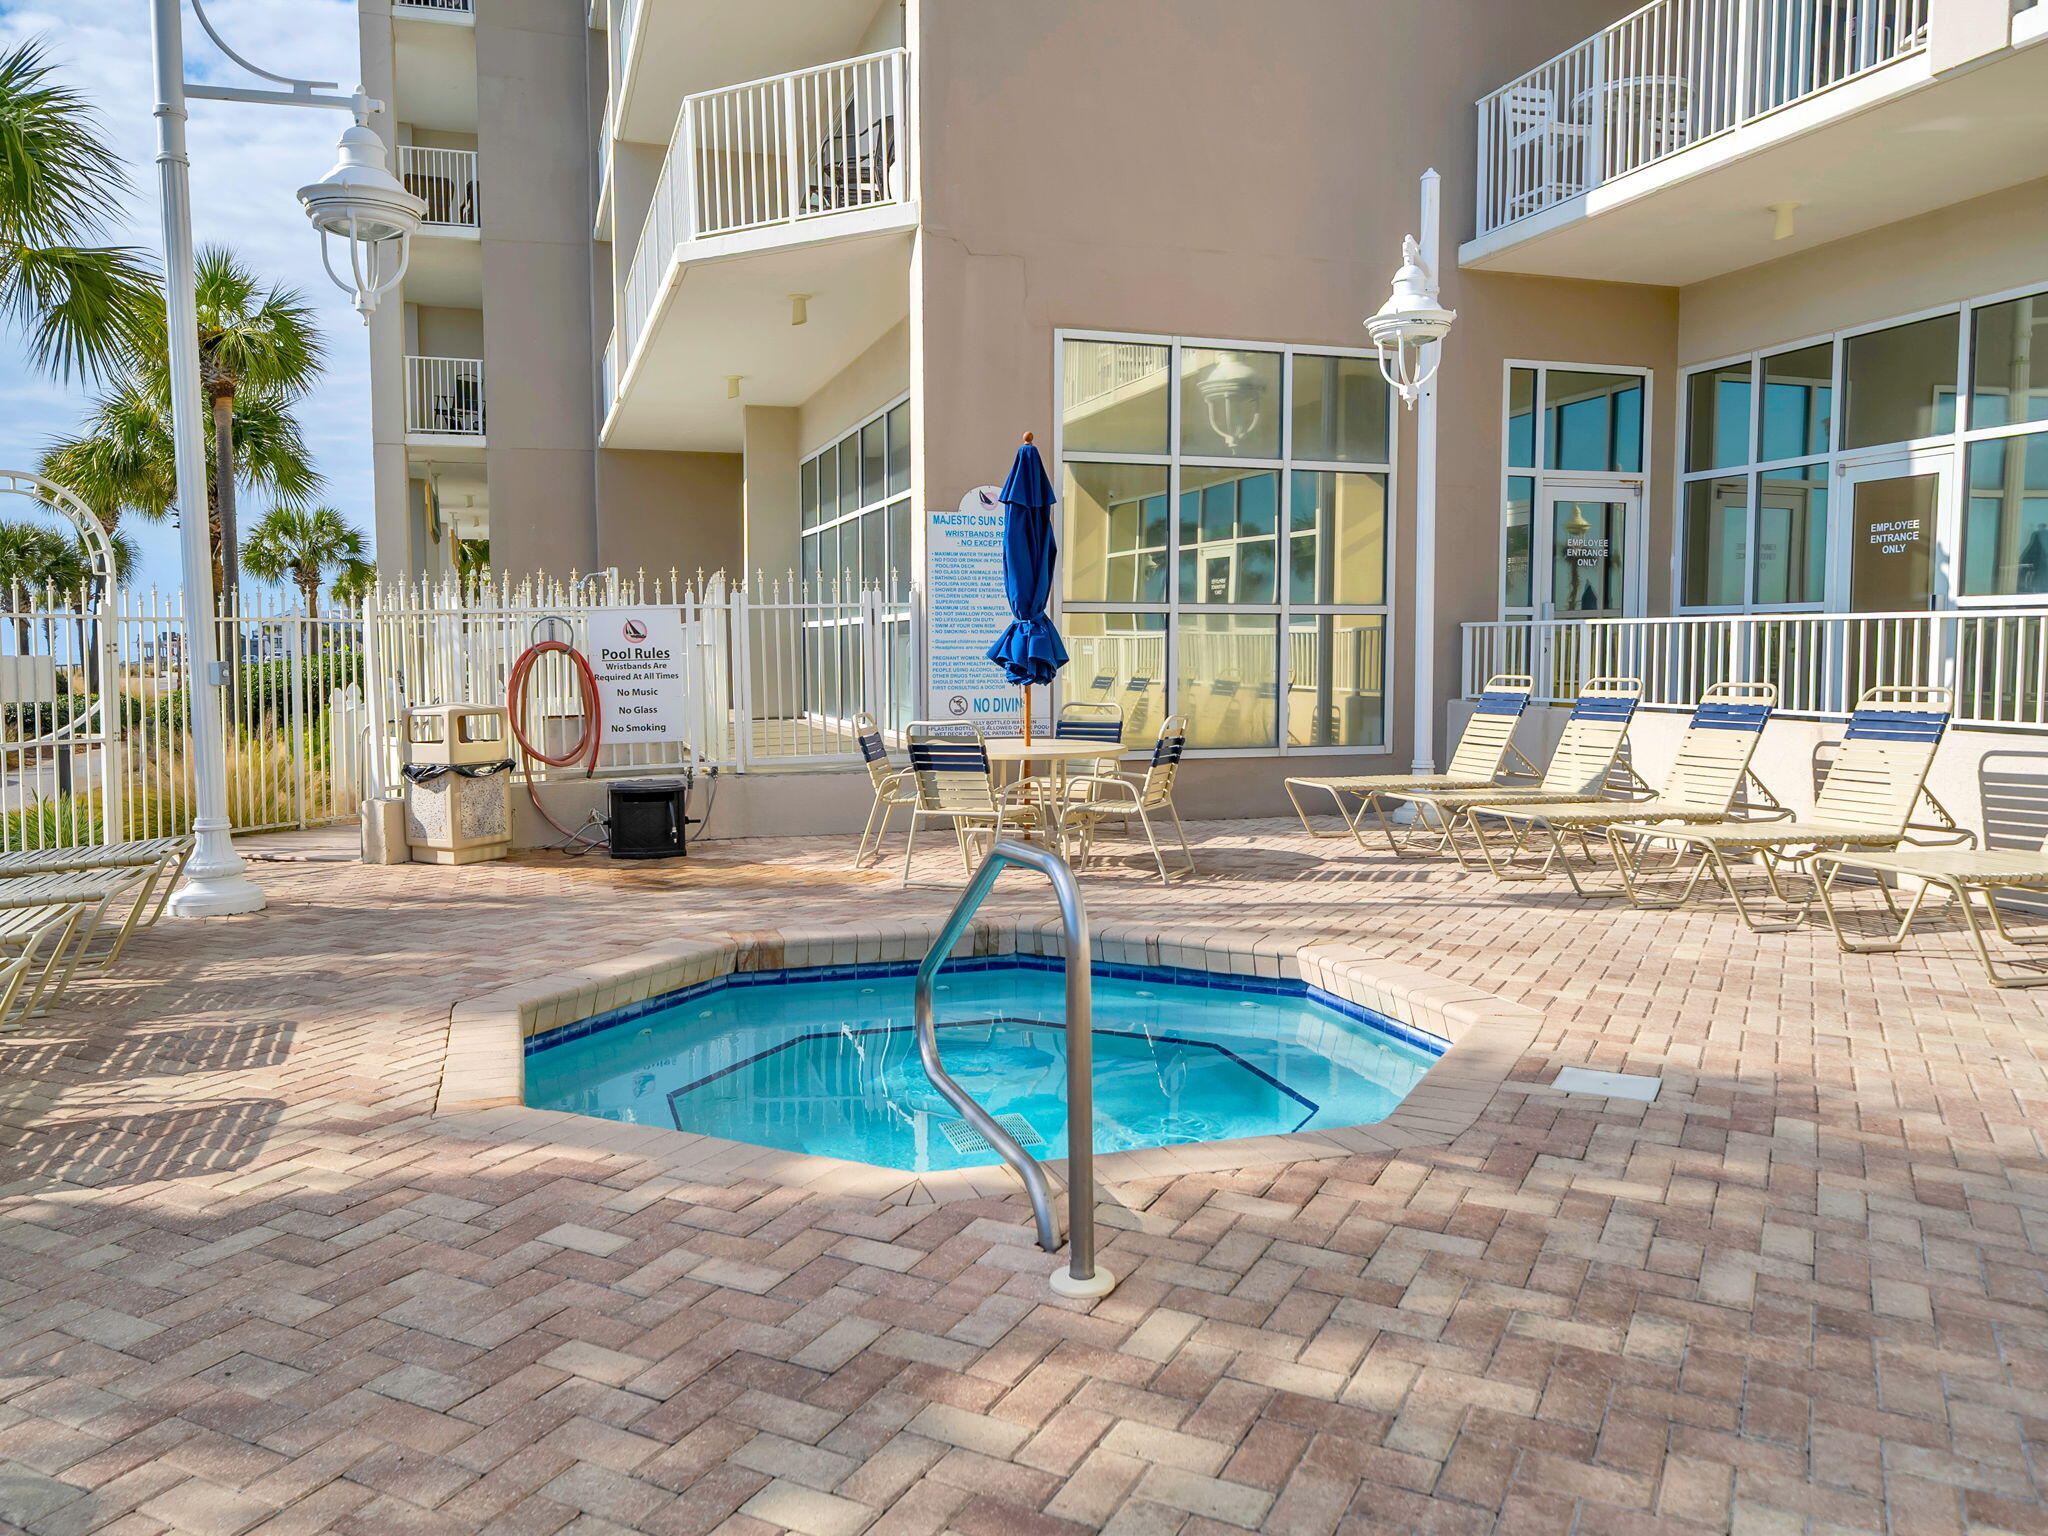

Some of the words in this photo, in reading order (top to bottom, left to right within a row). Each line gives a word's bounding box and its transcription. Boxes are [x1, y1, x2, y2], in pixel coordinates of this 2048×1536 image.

[933, 514, 976, 526] MAJESTIC
[978, 515, 996, 526] SUN
[1870, 520, 1920, 532] EMPLOYEE
[1567, 538, 1608, 546] EMPLOYEE
[1870, 531, 1920, 544] ENTRANCE
[1566, 548, 1608, 556] ENTRANCE
[1882, 544, 1907, 554] ONLY
[1577, 558, 1598, 566] ONLY
[602, 648, 631, 660] Pool
[634, 647, 670, 659] Rules
[594, 673, 631, 682] Required
[973, 698, 990, 712] NO
[993, 698, 1024, 712] DIVIN
[626, 724, 666, 732] Smoking
